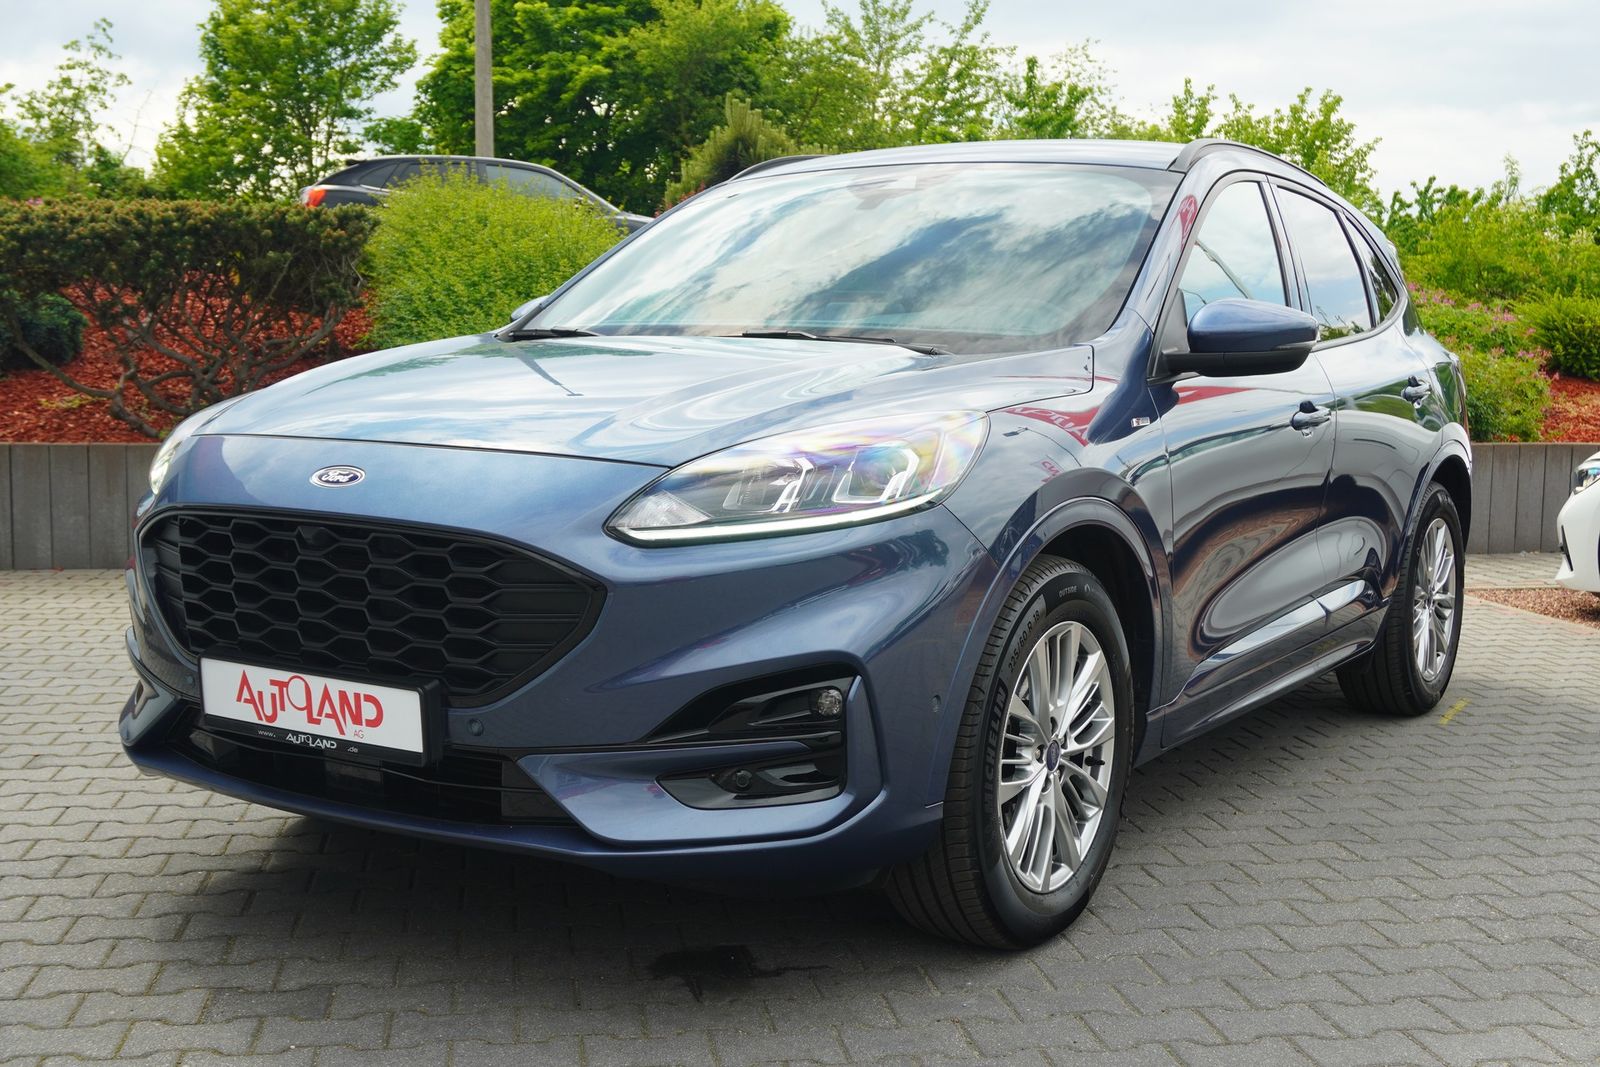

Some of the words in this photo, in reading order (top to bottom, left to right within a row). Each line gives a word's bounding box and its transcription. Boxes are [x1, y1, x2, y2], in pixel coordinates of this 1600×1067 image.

[321, 469, 354, 483] Ford
[1008, 630, 1027, 673] 225/60
[1027, 621, 1034, 633] R
[1033, 610, 1041, 623] 18
[236, 670, 384, 736] AUTOLAND
[257, 729, 276, 738] www.
[285, 732, 337, 749] AUTOLAND
[353, 729, 365, 739] AG
[983, 686, 1008, 814] MICHELIN
